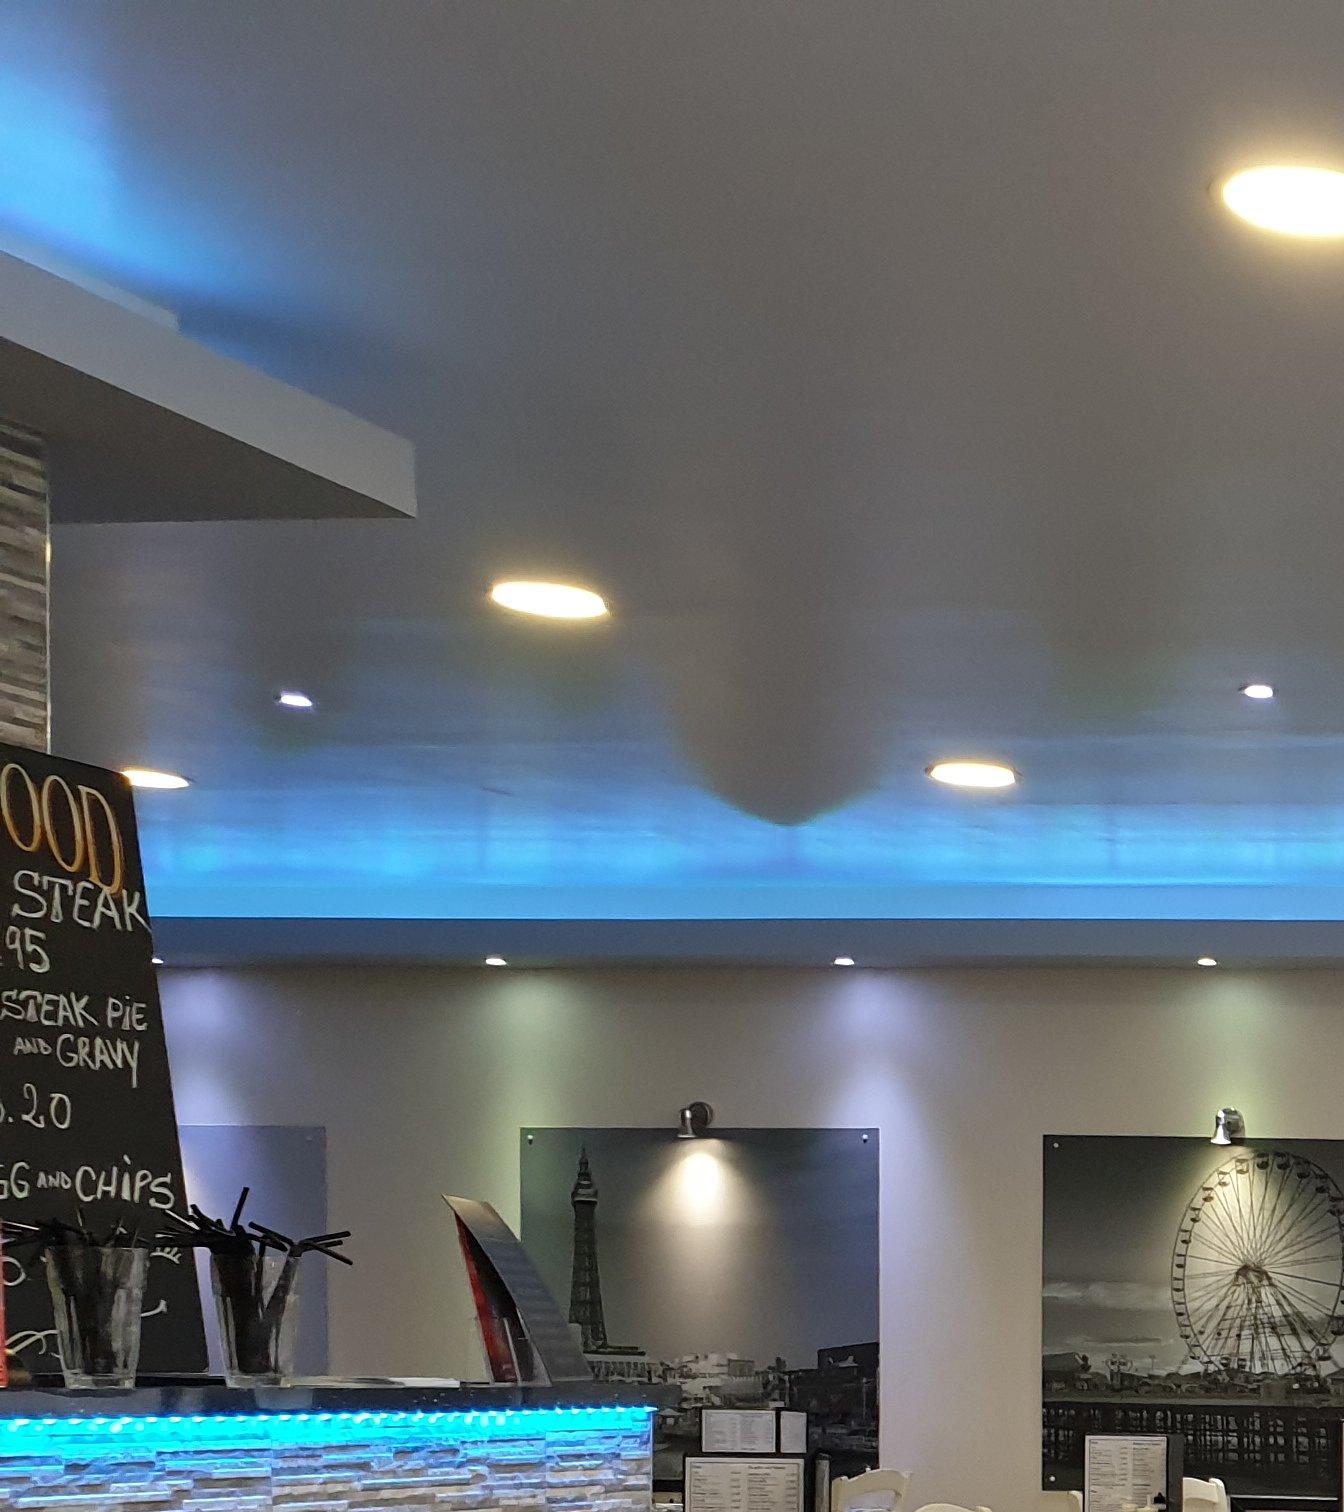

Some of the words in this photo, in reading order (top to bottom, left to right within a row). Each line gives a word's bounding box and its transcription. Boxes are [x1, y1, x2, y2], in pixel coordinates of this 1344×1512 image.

[12, 870, 152, 932] STEAK
[0, 990, 99, 1028] STEAK
[13, 1036, 53, 1055] AND
[56, 1033, 140, 1089] GRAVY
[37, 1171, 72, 1189] AND
